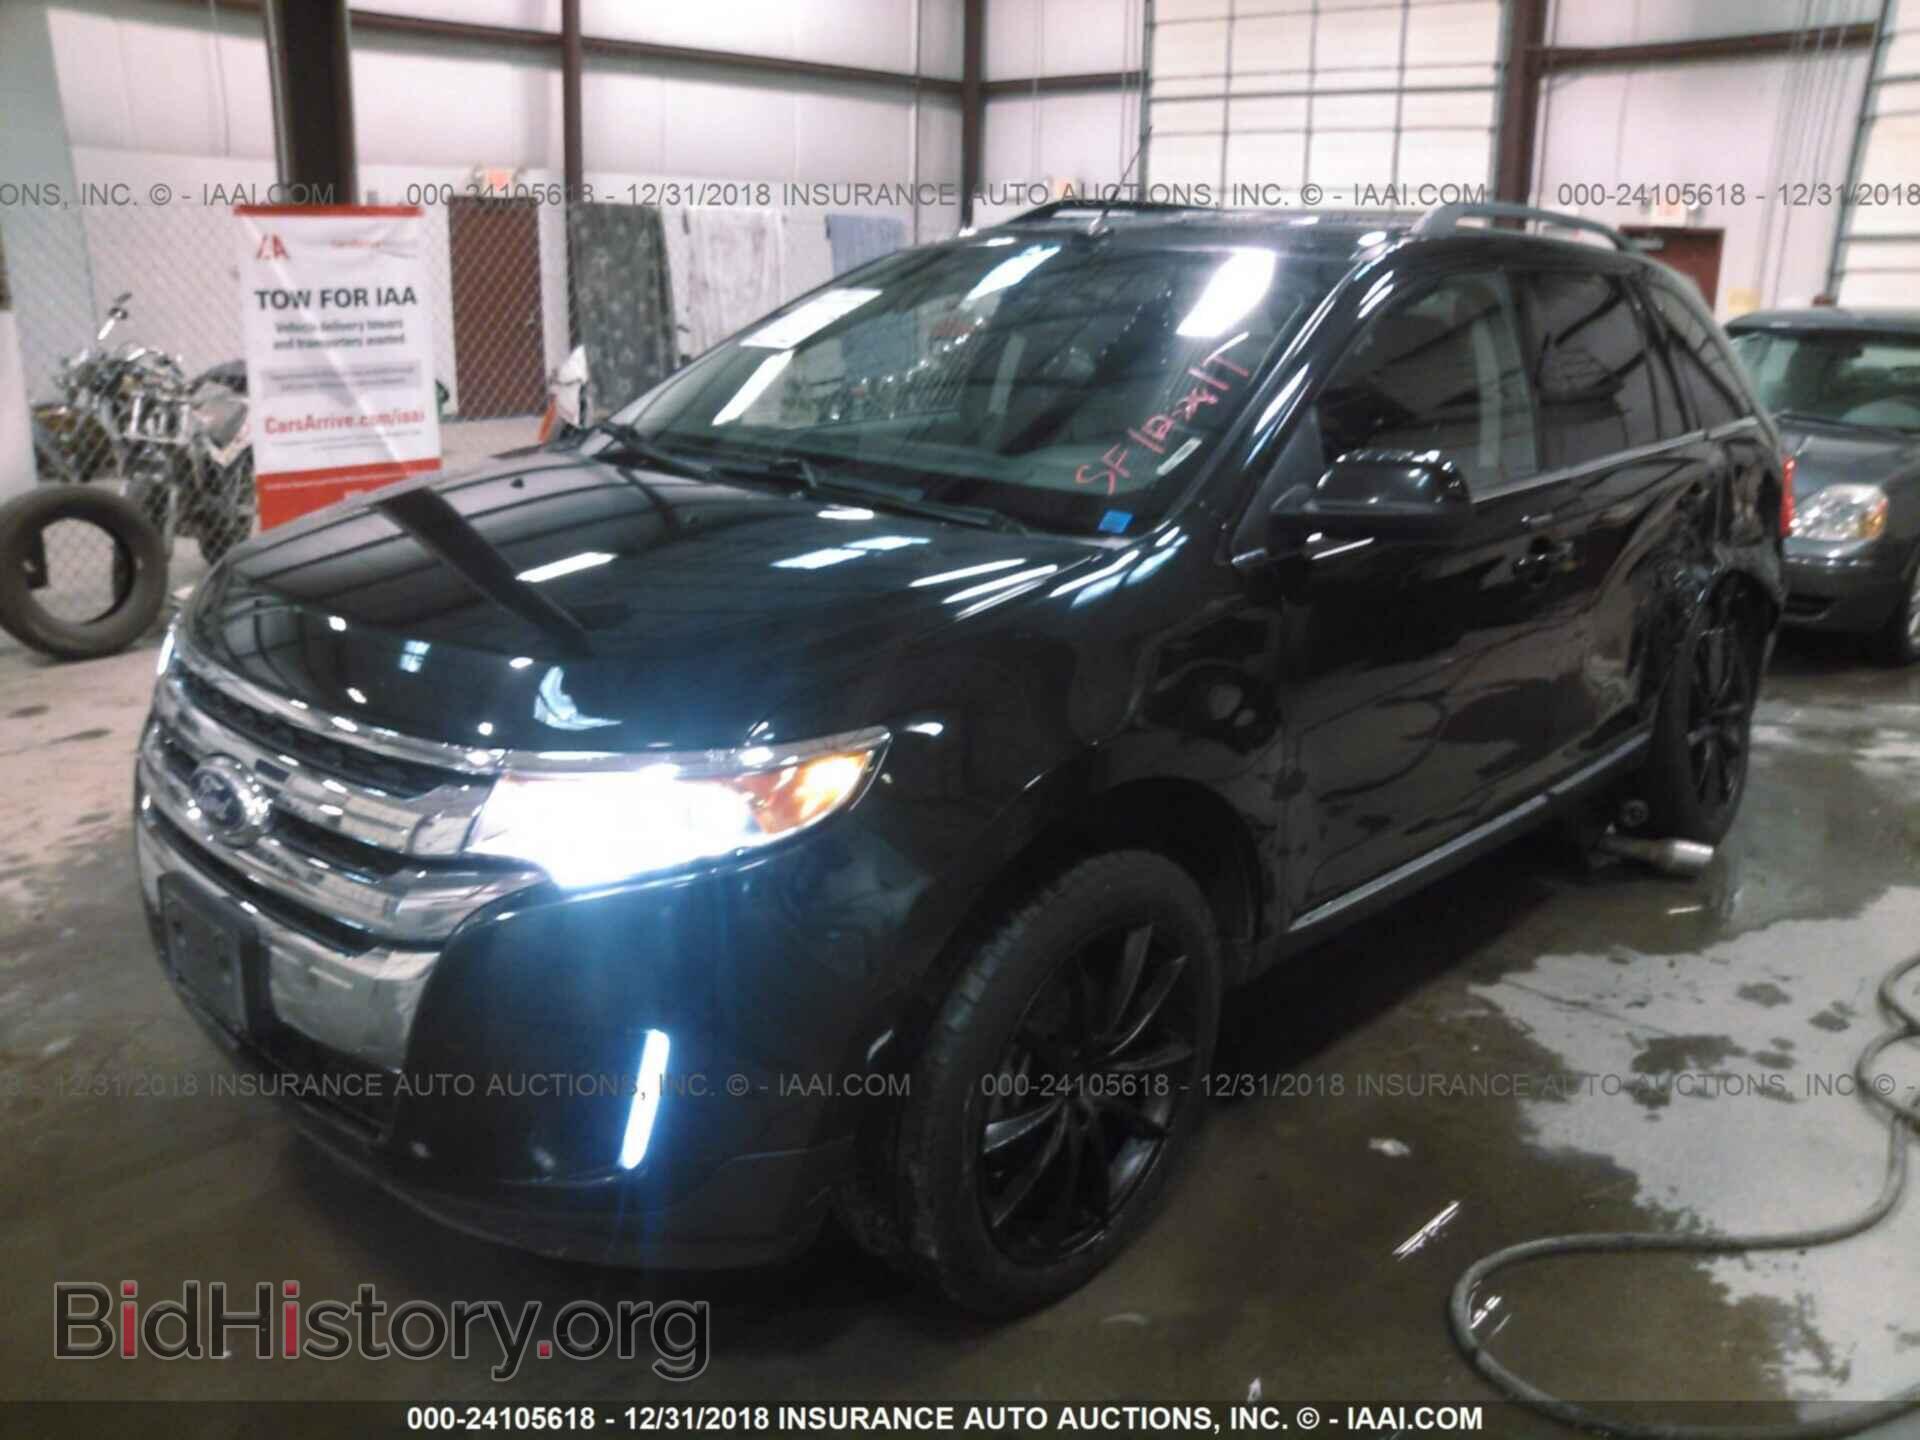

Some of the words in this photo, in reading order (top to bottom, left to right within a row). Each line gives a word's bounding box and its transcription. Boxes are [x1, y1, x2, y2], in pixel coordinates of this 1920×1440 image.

[255, 289, 311, 309] TOW
[320, 288, 368, 308] FOR
[376, 286, 417, 306] IAA
